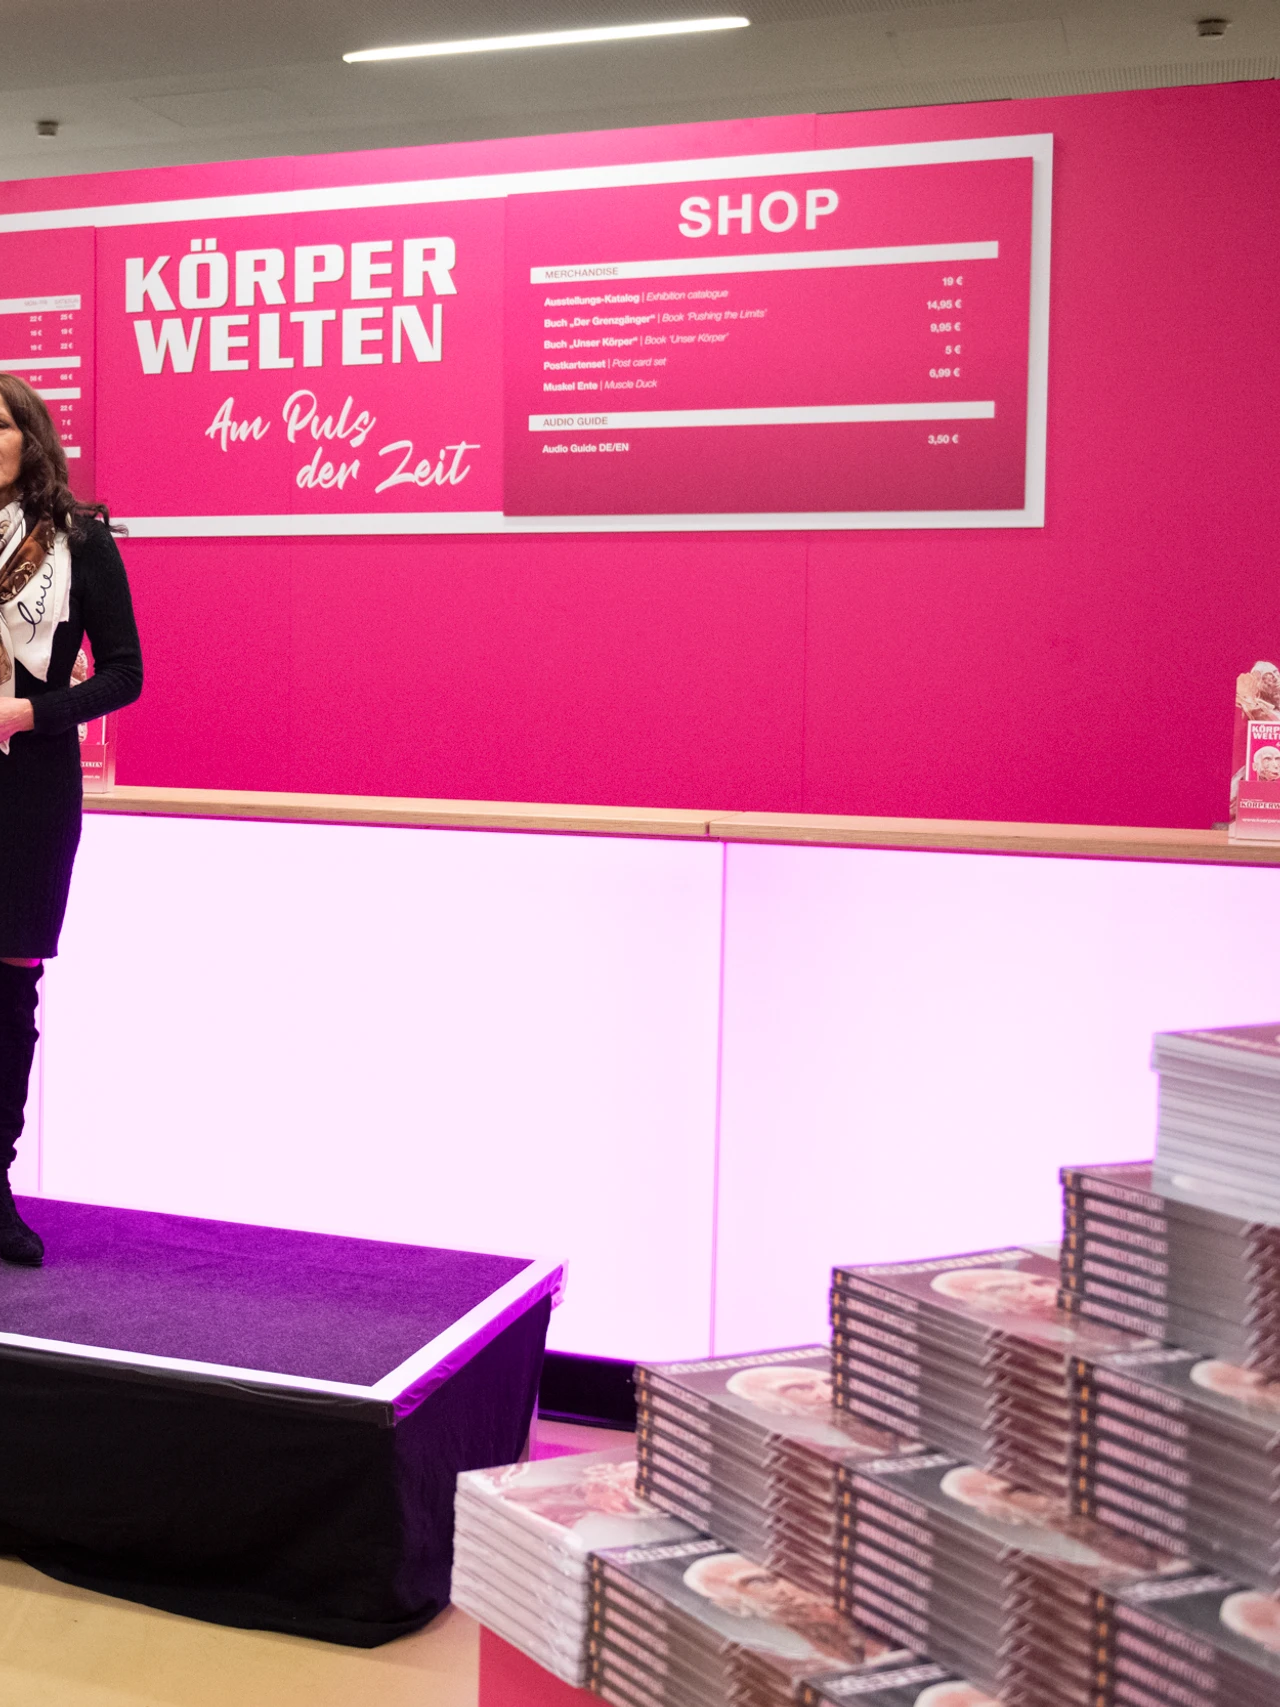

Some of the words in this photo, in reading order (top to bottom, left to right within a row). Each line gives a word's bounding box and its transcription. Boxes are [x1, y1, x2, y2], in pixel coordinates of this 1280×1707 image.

[678, 188, 841, 239] SHOP
[125, 237, 458, 313] KÖRPER
[545, 267, 619, 279] MERCHANDISE
[942, 276, 954, 286] 19
[544, 293, 640, 307] Ausstellungs-Katalog
[646, 291, 686, 302] Exhibition
[687, 289, 729, 300] catalogue
[926, 299, 953, 311] 14,95
[954, 298, 962, 309] €
[544, 319, 567, 328] Buch
[662, 313, 684, 323] Book
[724, 310, 738, 320] the
[930, 322, 952, 333] 9,95
[133, 303, 442, 375] WELTEN
[544, 340, 567, 350] Buch
[644, 335, 666, 345] Book
[945, 345, 952, 355] 5
[544, 360, 606, 370] Postkartenset
[612, 358, 631, 368] Post
[633, 358, 652, 367] card
[653, 357, 667, 367] set
[929, 367, 951, 379] 6,99
[544, 382, 575, 392] Muskel
[577, 381, 598, 390] Ente
[604, 380, 634, 390] Muscle
[635, 379, 658, 389] Duck
[205, 396, 271, 452] Am
[282, 389, 376, 448] Puls
[543, 417, 574, 427] AUDIO
[577, 416, 608, 426] GUIDE
[928, 434, 950, 445] 3,50
[952, 434, 959, 444] €
[542, 444, 568, 453] Audio
[570, 443, 596, 453] Guide
[598, 442, 629, 452] DE/EN
[296, 446, 361, 490] der
[374, 439, 481, 494] Zeit
[1252, 723, 1280, 733] KÖRP
